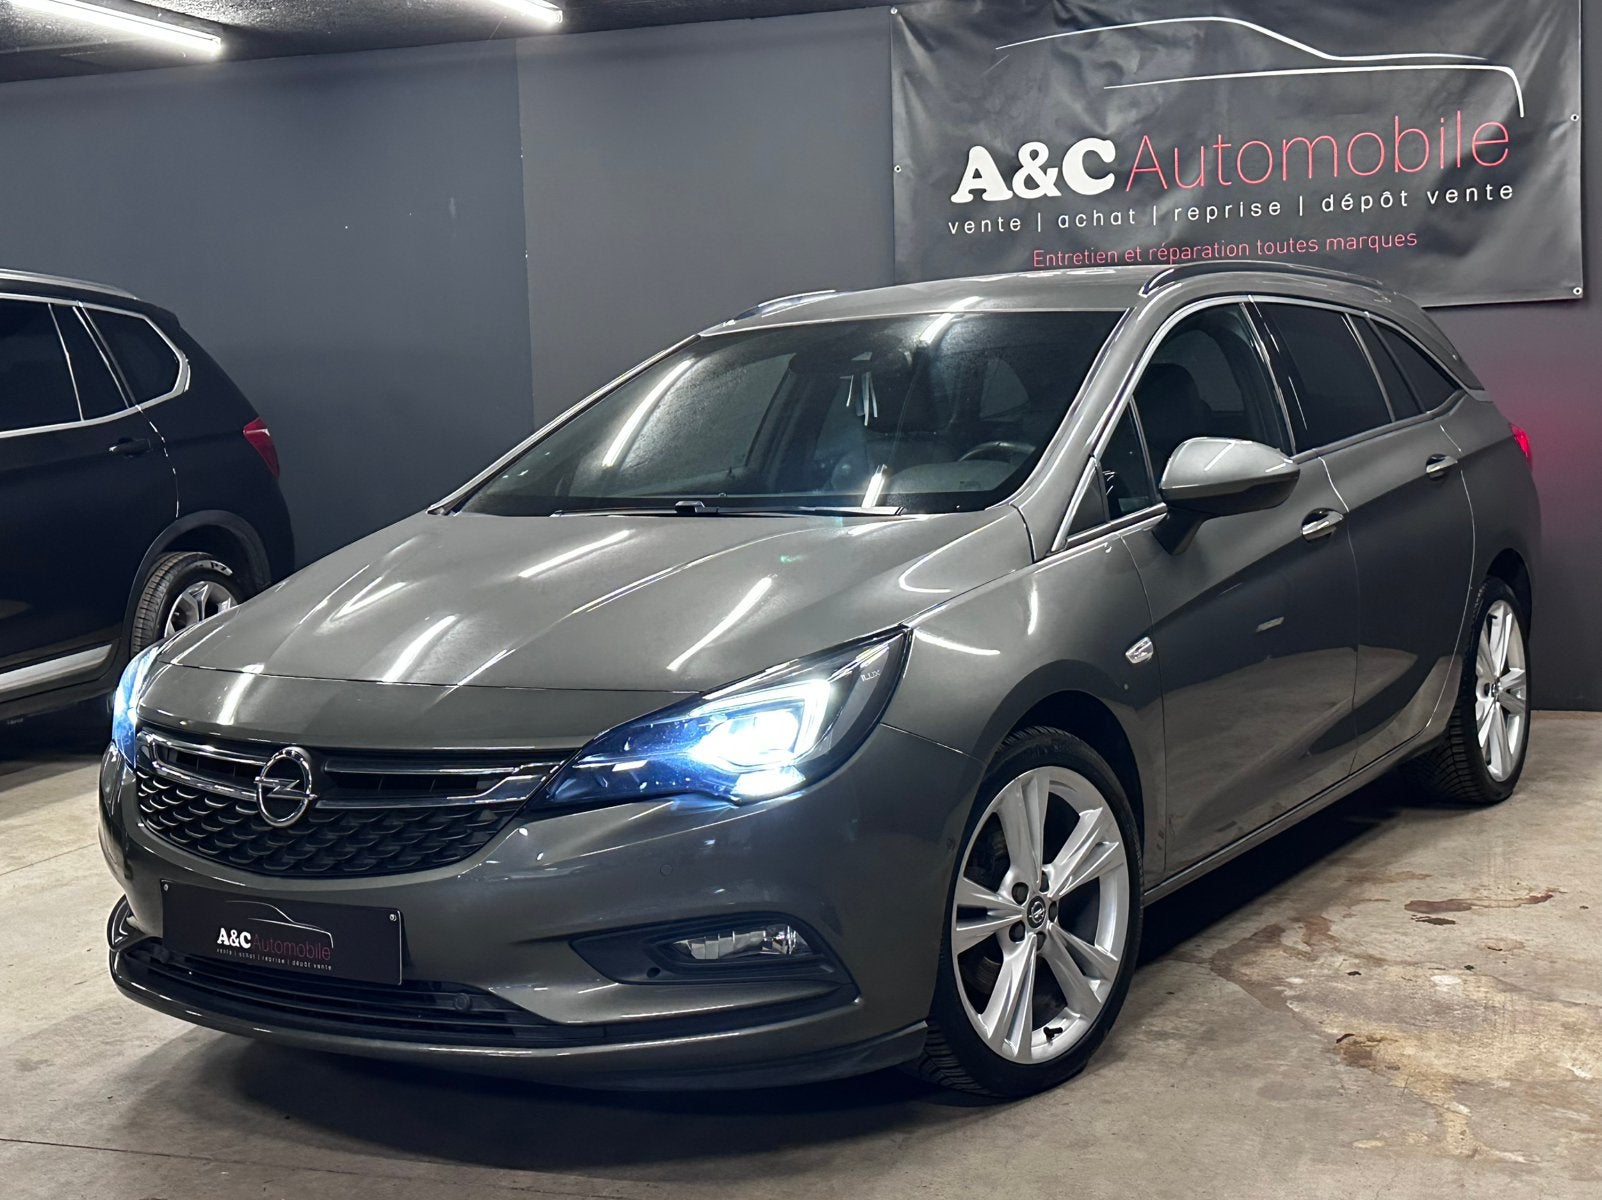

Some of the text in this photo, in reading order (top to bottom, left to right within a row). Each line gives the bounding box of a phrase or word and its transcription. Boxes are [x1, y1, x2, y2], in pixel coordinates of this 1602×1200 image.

[950, 111, 1510, 205] A&C Automobile
[948, 216, 1021, 235] vente
[1057, 208, 1136, 229] achat
[1174, 201, 1281, 224] reprise
[1321, 189, 1408, 214] dépôt
[1426, 183, 1514, 205] vente
[1032, 233, 1418, 267] Entretien et réparation toutes marques
[217, 928, 331, 960] A&C Automobile
